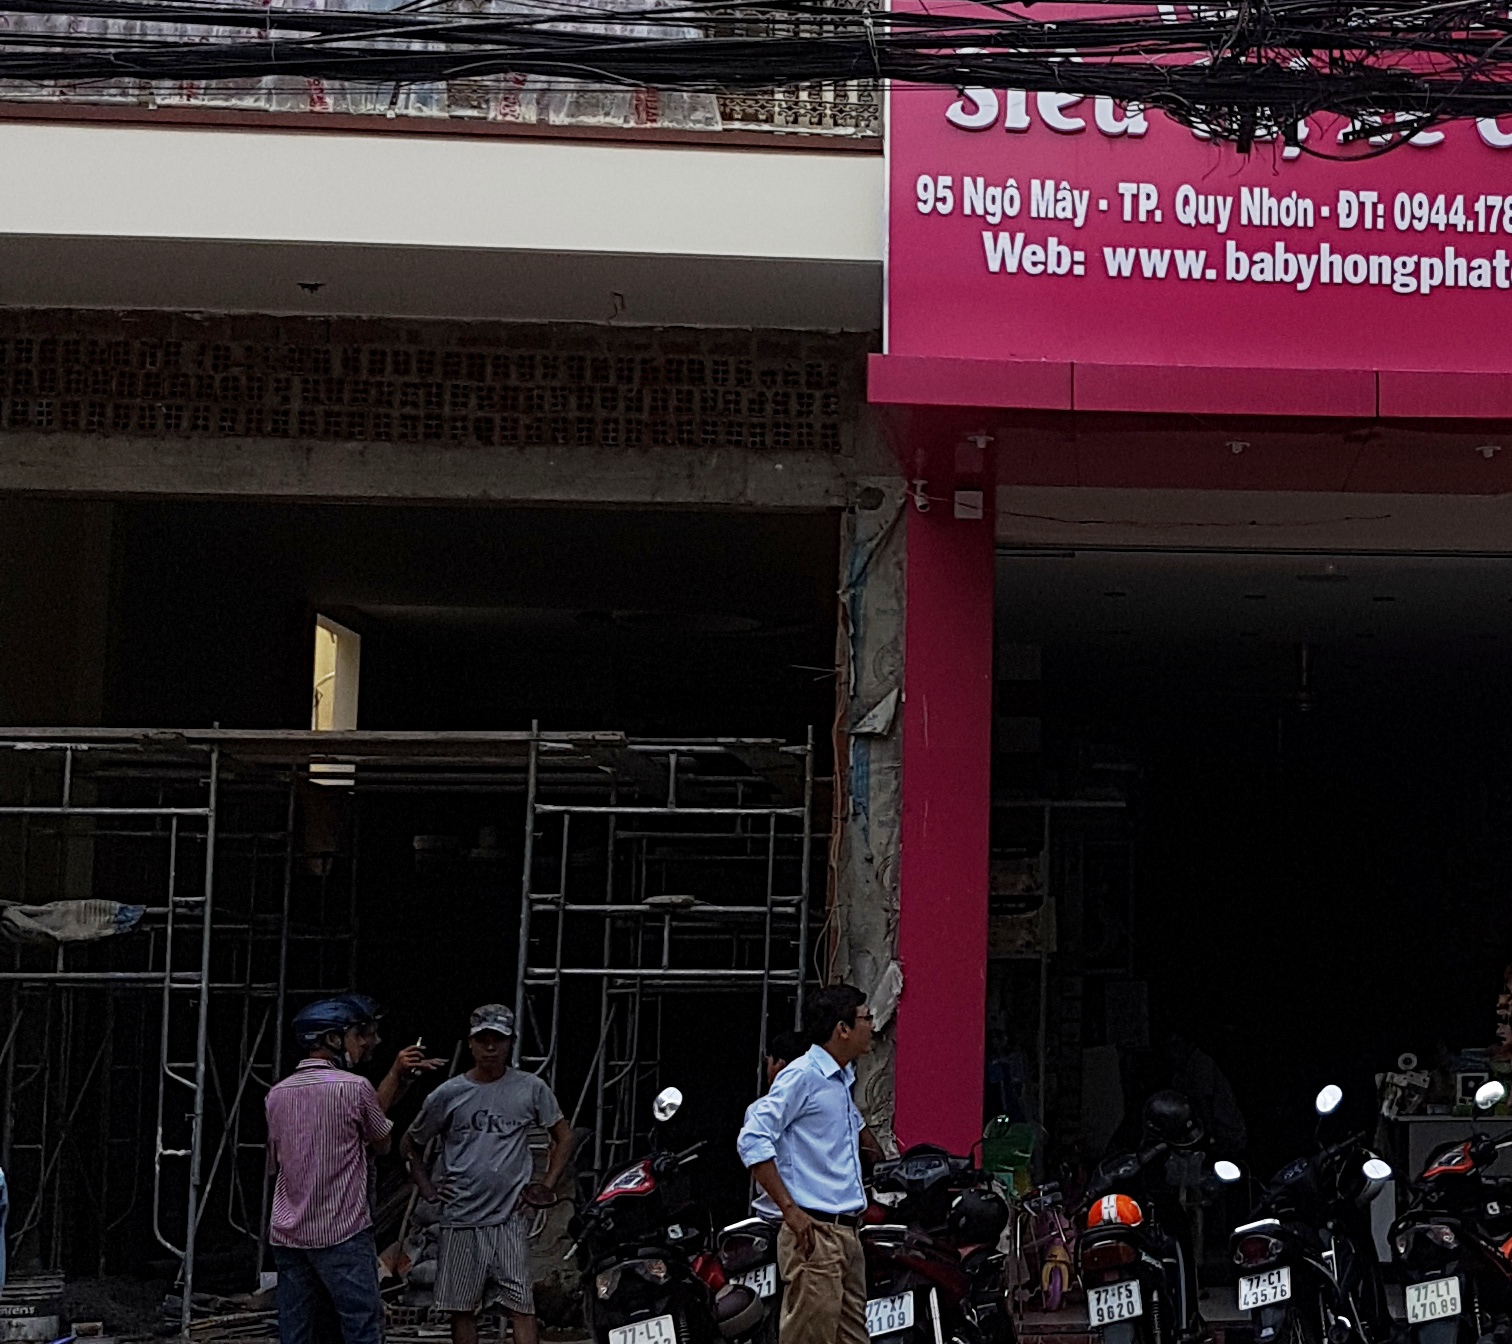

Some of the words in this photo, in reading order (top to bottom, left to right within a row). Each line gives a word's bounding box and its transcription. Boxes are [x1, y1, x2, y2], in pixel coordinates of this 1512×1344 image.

[916, 175, 954, 215] 95
[963, 177, 1021, 224] Ngô
[1030, 179, 1090, 228] Mây
[1118, 182, 1162, 223] TP.
[1175, 184, 1233, 233] Quy
[1239, 186, 1315, 228] Nhơn
[1337, 190, 1385, 229] ĐT:
[982, 230, 1086, 276] Web:
[1247, 1270, 1281, 1292] 77-C1
[1414, 1280, 1450, 1303] 77-L1
[1243, 1283, 1287, 1306] 435.76
[1096, 1300, 1135, 1323] 9620
[1411, 1296, 1457, 1320] 470.89
